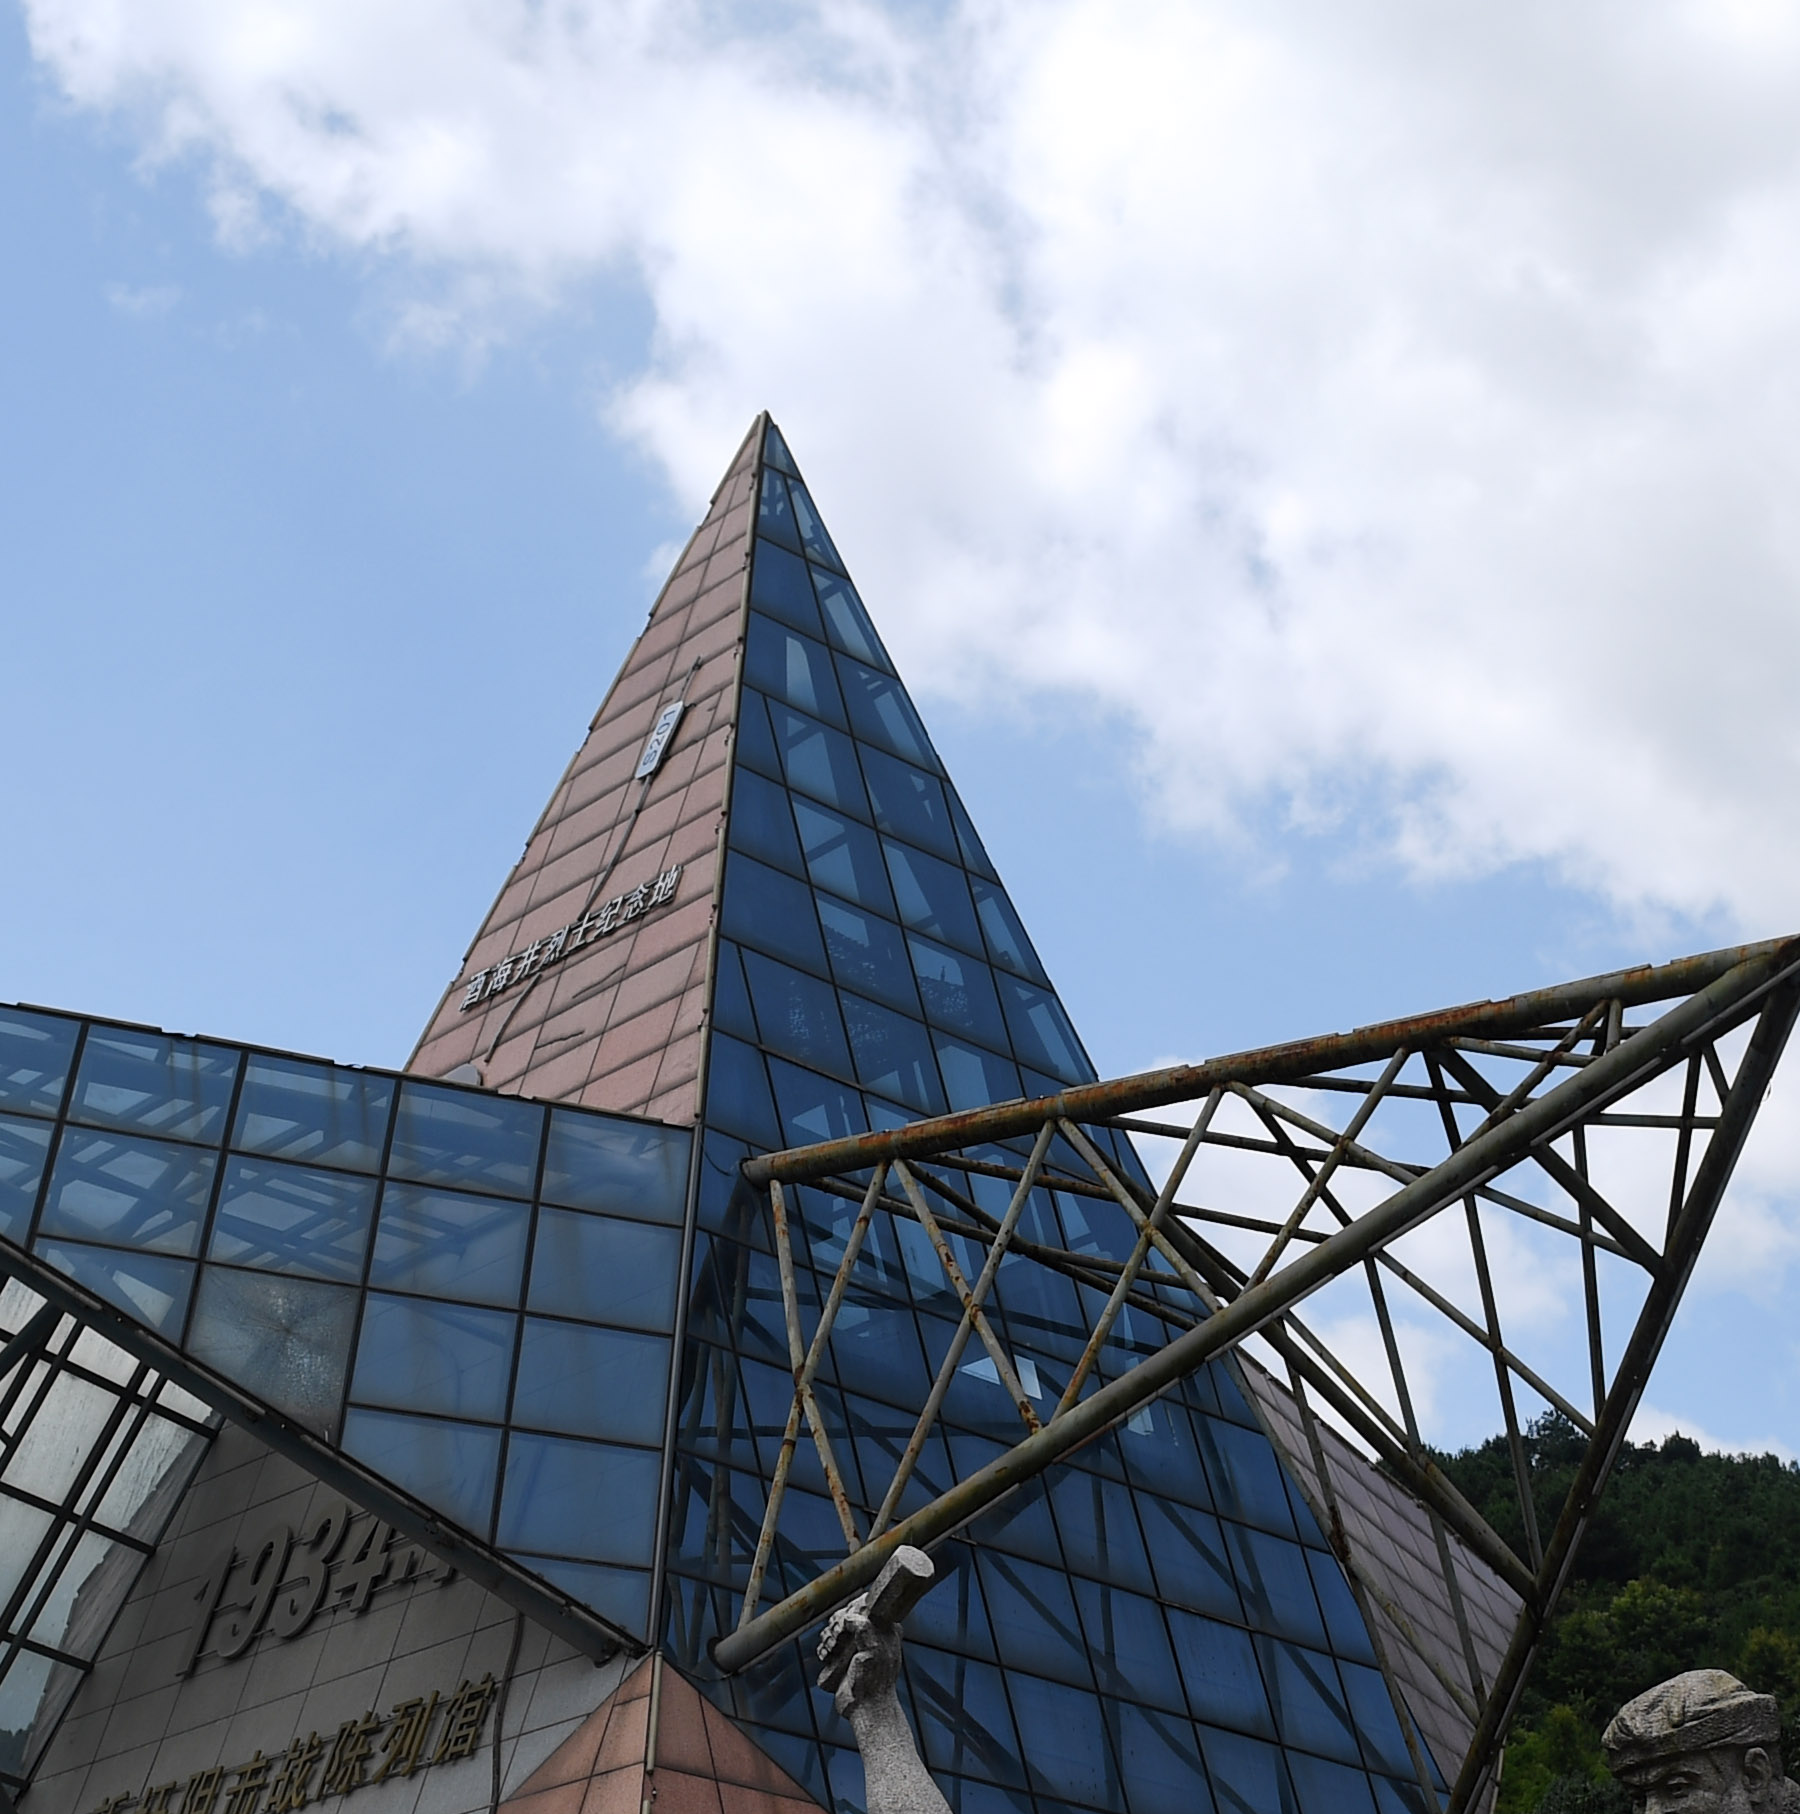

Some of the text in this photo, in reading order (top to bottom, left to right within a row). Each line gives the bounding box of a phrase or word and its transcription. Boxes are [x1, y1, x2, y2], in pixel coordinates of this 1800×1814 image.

[458, 864, 683, 1013] 酒海井烈士纪念地
